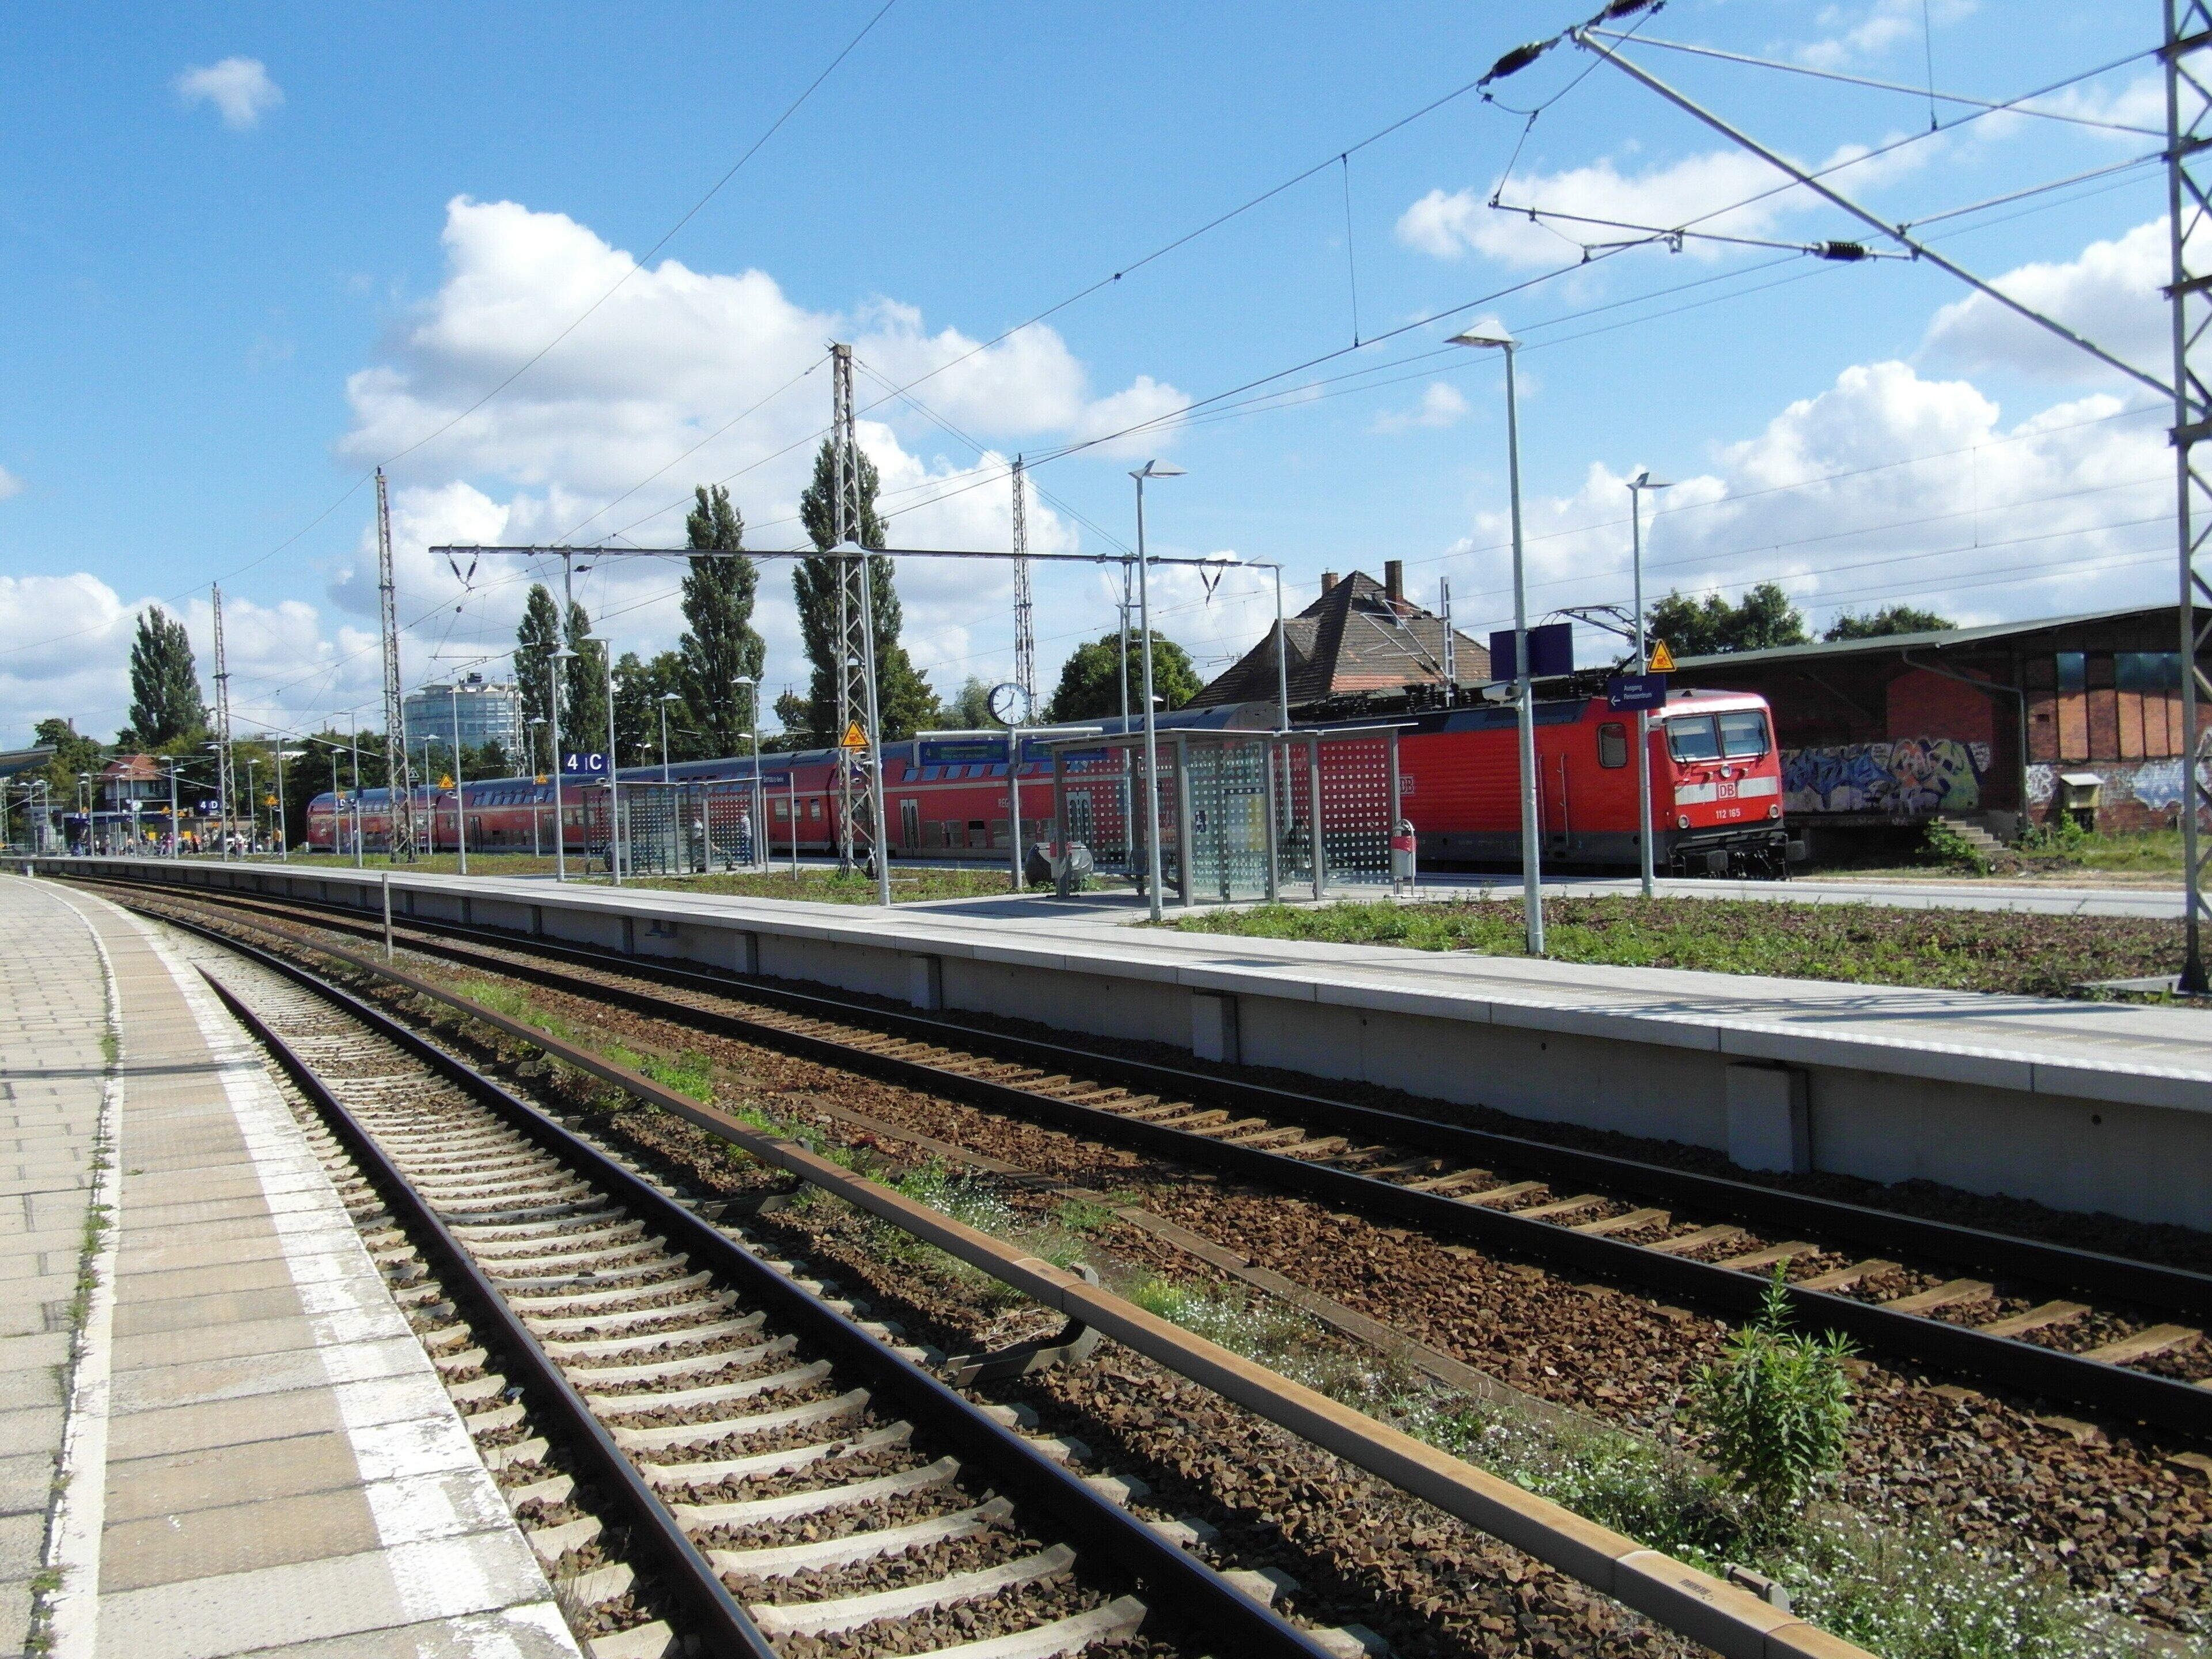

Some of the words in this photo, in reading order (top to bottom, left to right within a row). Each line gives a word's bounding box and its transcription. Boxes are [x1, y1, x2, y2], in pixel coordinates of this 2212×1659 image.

[925, 749, 931, 757] 4
[567, 754, 578, 770] 4
[589, 753, 602, 770] C
[1400, 778, 1413, 793] DB
[1719, 784, 1734, 797] DB
[210, 801, 218, 809] D
[1716, 809, 1726, 820] 112
[1729, 808, 1740, 818] 165
[941, 822, 945, 834] 2
[1037, 820, 1041, 834] 2
